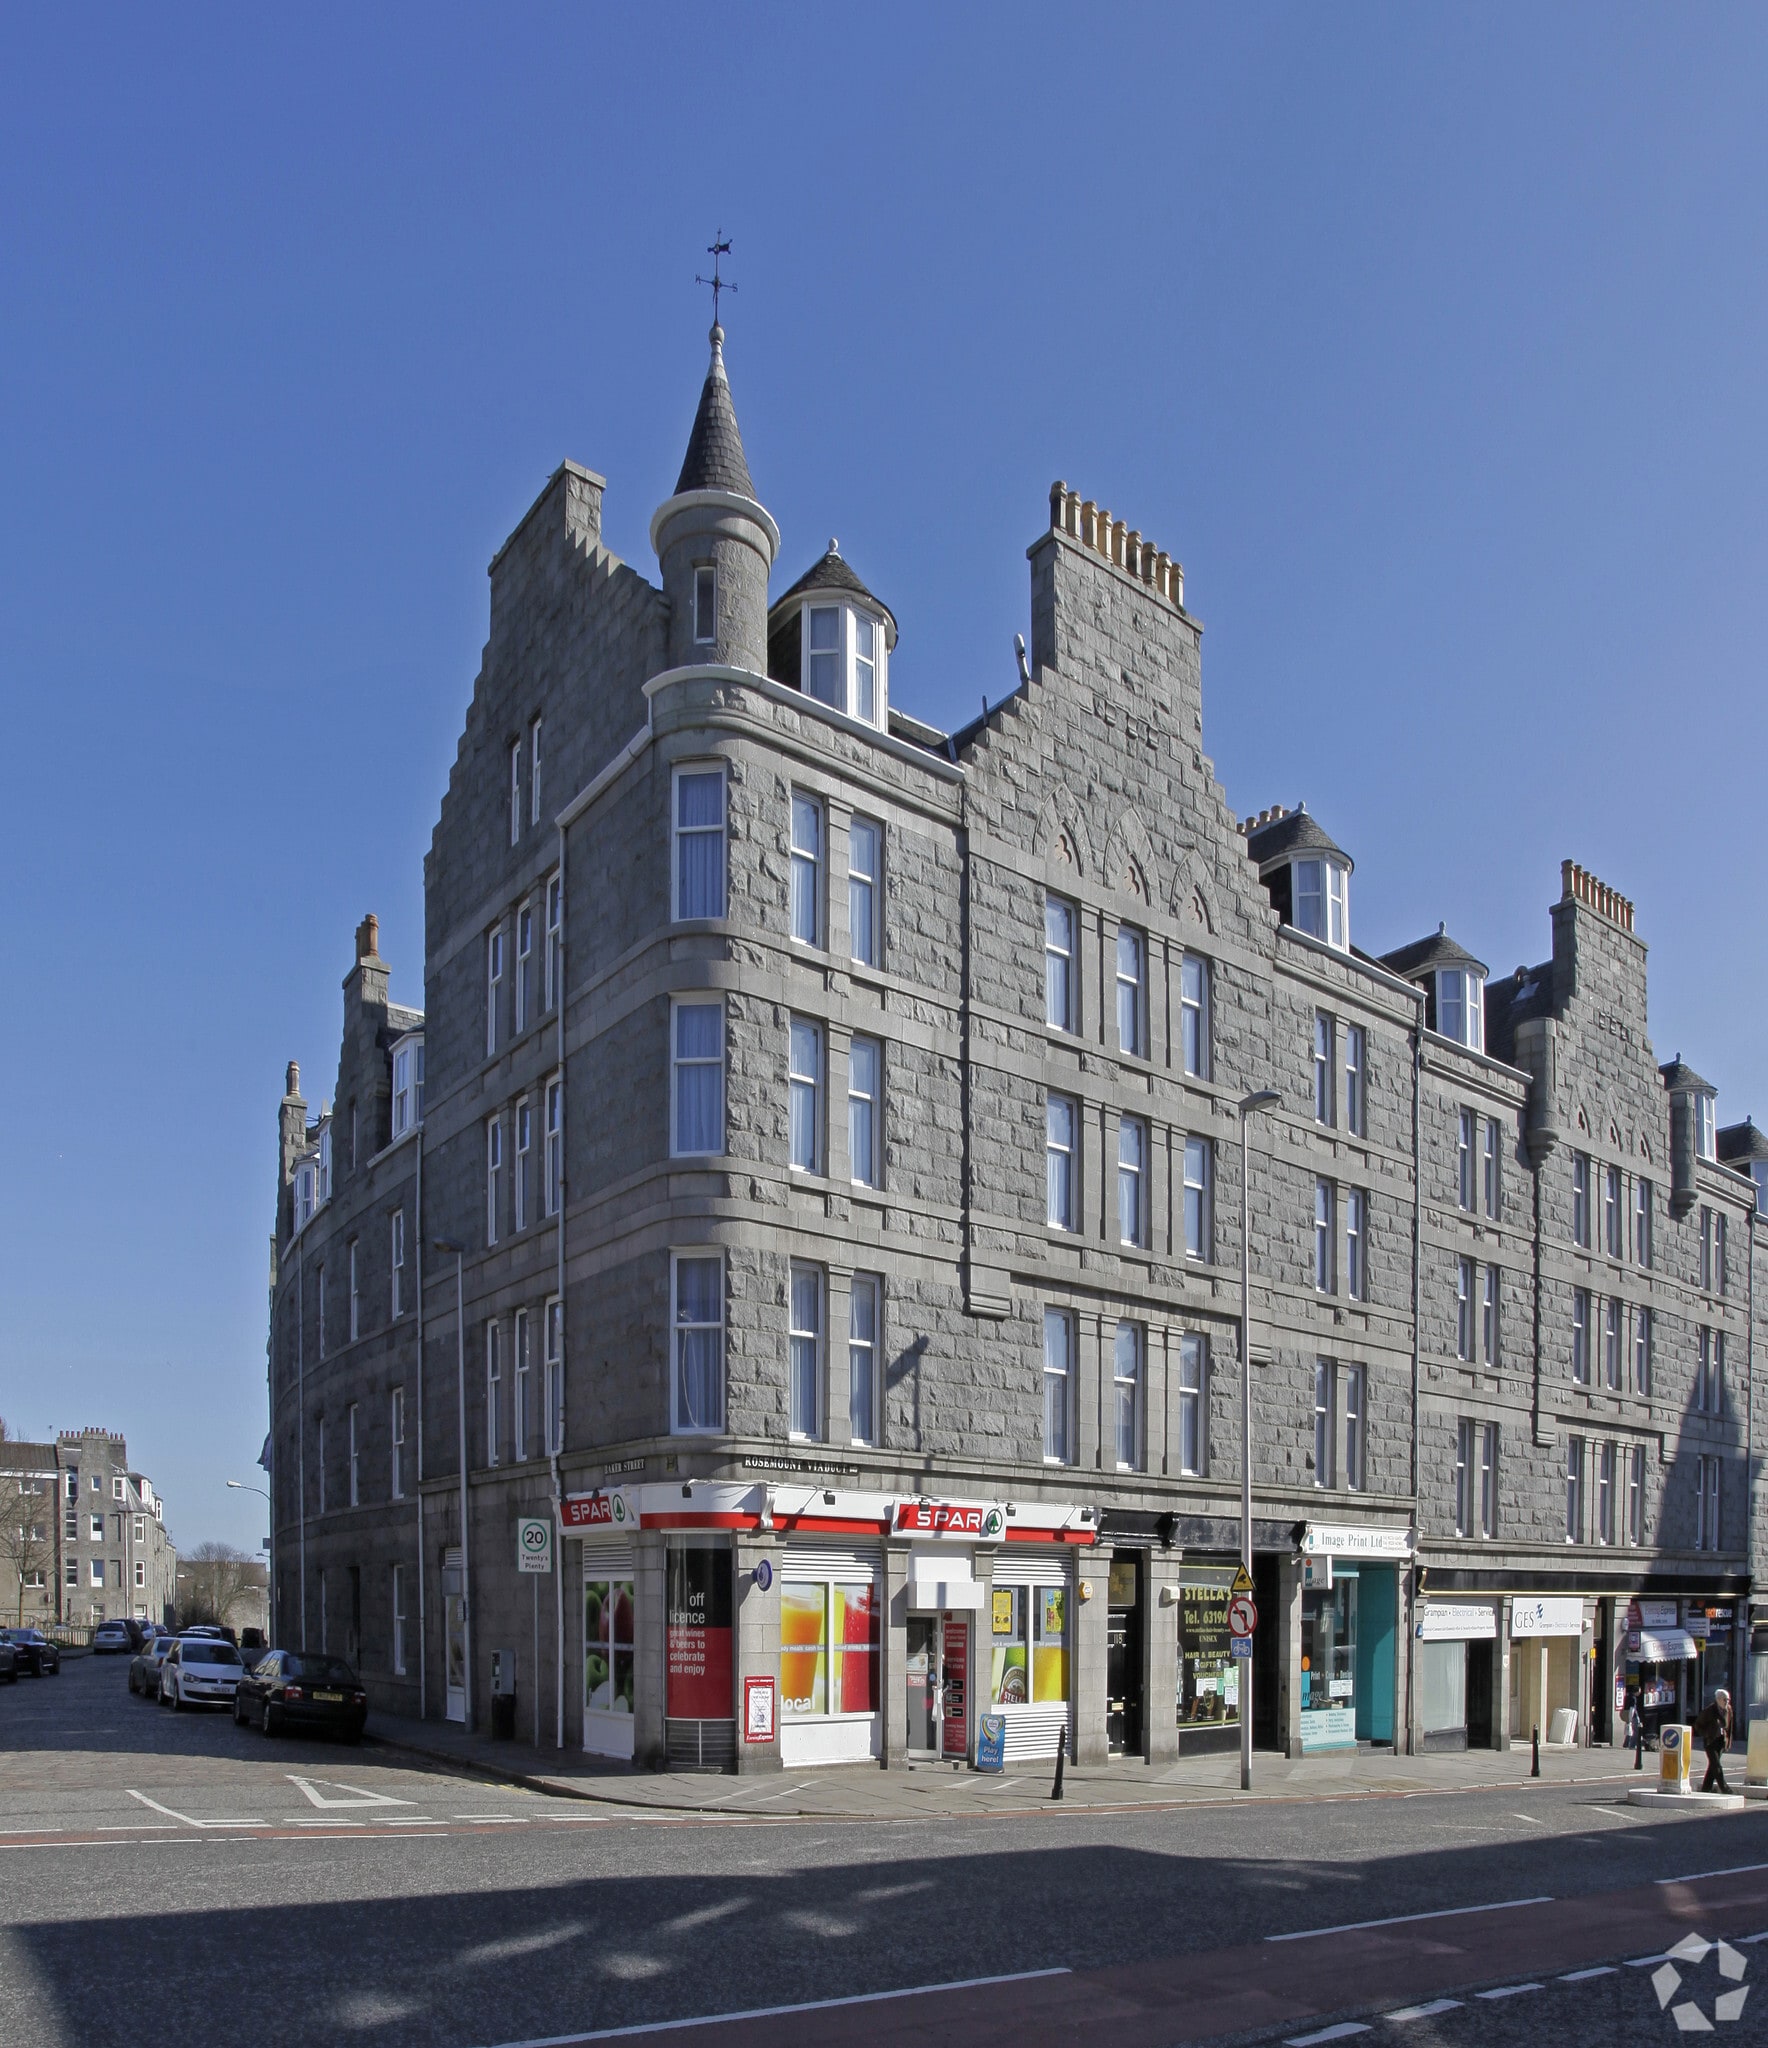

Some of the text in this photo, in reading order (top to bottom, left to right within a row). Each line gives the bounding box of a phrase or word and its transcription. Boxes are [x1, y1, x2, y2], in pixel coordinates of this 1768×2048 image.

[604, 1458, 645, 1475] BAKER STREET
[745, 1456, 802, 1471] ROSEMOUNT
[807, 1461, 847, 1474] VIADUCT
[570, 1501, 611, 1522] SPAR
[917, 1510, 981, 1529] SPAR
[526, 1530, 544, 1544] 20
[1321, 1532, 1383, 1549] Image Print Ltd
[522, 1554, 548, 1562] Twenty's
[525, 1562, 545, 1570] Plenty
[689, 1592, 705, 1607] off
[1184, 1586, 1232, 1601] STELLA'S
[669, 1609, 706, 1624] licence
[1184, 1609, 1200, 1625] Tel.
[1424, 1607, 1448, 1620] Grampian
[1452, 1607, 1474, 1617] Electrical
[1514, 1611, 1535, 1629] GES
[685, 1629, 705, 1638] wines
[675, 1640, 696, 1649] beers
[697, 1640, 706, 1649] to
[669, 1651, 706, 1662] celebrate
[1185, 1651, 1199, 1659] HAIR
[1208, 1650, 1231, 1658] BEAUTY
[669, 1664, 706, 1676] and enjoy
[1310, 1671, 1320, 1680] Print
[781, 1694, 815, 1711] local
[984, 1745, 998, 1755] Play
